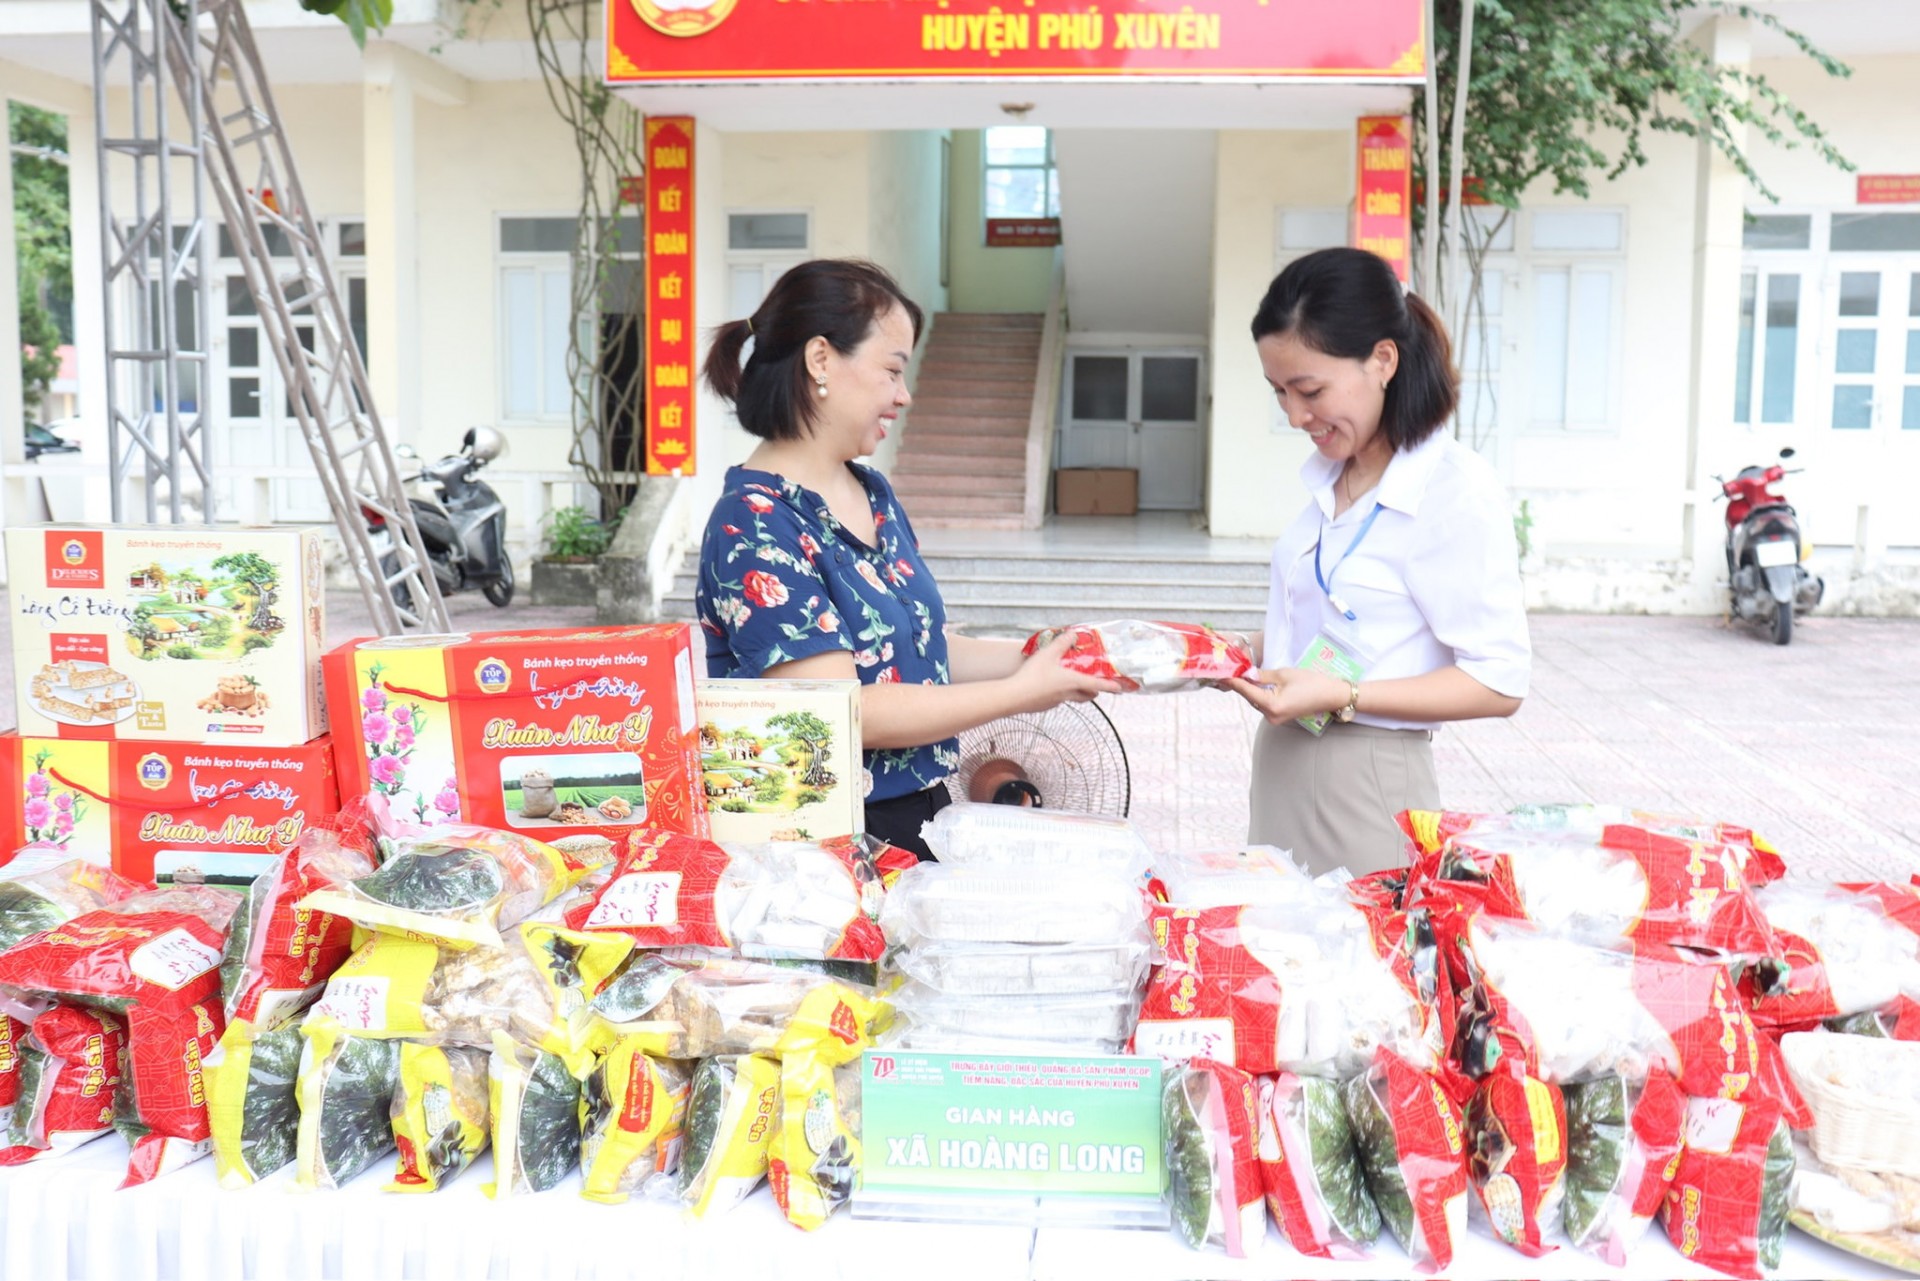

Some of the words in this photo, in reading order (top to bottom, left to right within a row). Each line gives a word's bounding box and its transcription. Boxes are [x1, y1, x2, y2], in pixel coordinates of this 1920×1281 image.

[921, 6, 1030, 58] HUYỆN
[1038, 5, 1104, 50] PHÚ
[1113, 5, 1220, 50] XUYÊN
[523, 657, 552, 669] Bánh
[554, 656, 574, 669] kẹo
[575, 654, 612, 668] truyền
[613, 652, 648, 667] thống
[482, 717, 553, 748] Xuân
[554, 714, 618, 747] Như
[624, 704, 654, 743] Ý
[183, 756, 213, 767] Bánh
[213, 757, 233, 769] kẹo
[234, 758, 269, 771] truyền
[270, 758, 304, 772] thống
[139, 812, 207, 843] Xuân
[209, 814, 274, 845] Như
[275, 810, 305, 845] Ý
[82, 1033, 104, 1067] Sản
[183, 1038, 201, 1072] Sản
[81, 1067, 106, 1097] Đặc
[188, 1071, 206, 1107] Đặc
[946, 1107, 1002, 1125] GIAN
[1009, 1104, 1076, 1127] HÀNG
[886, 1133, 931, 1167] XÃ
[938, 1134, 1050, 1172] HOÀNG
[1058, 1142, 1145, 1174] LONG
